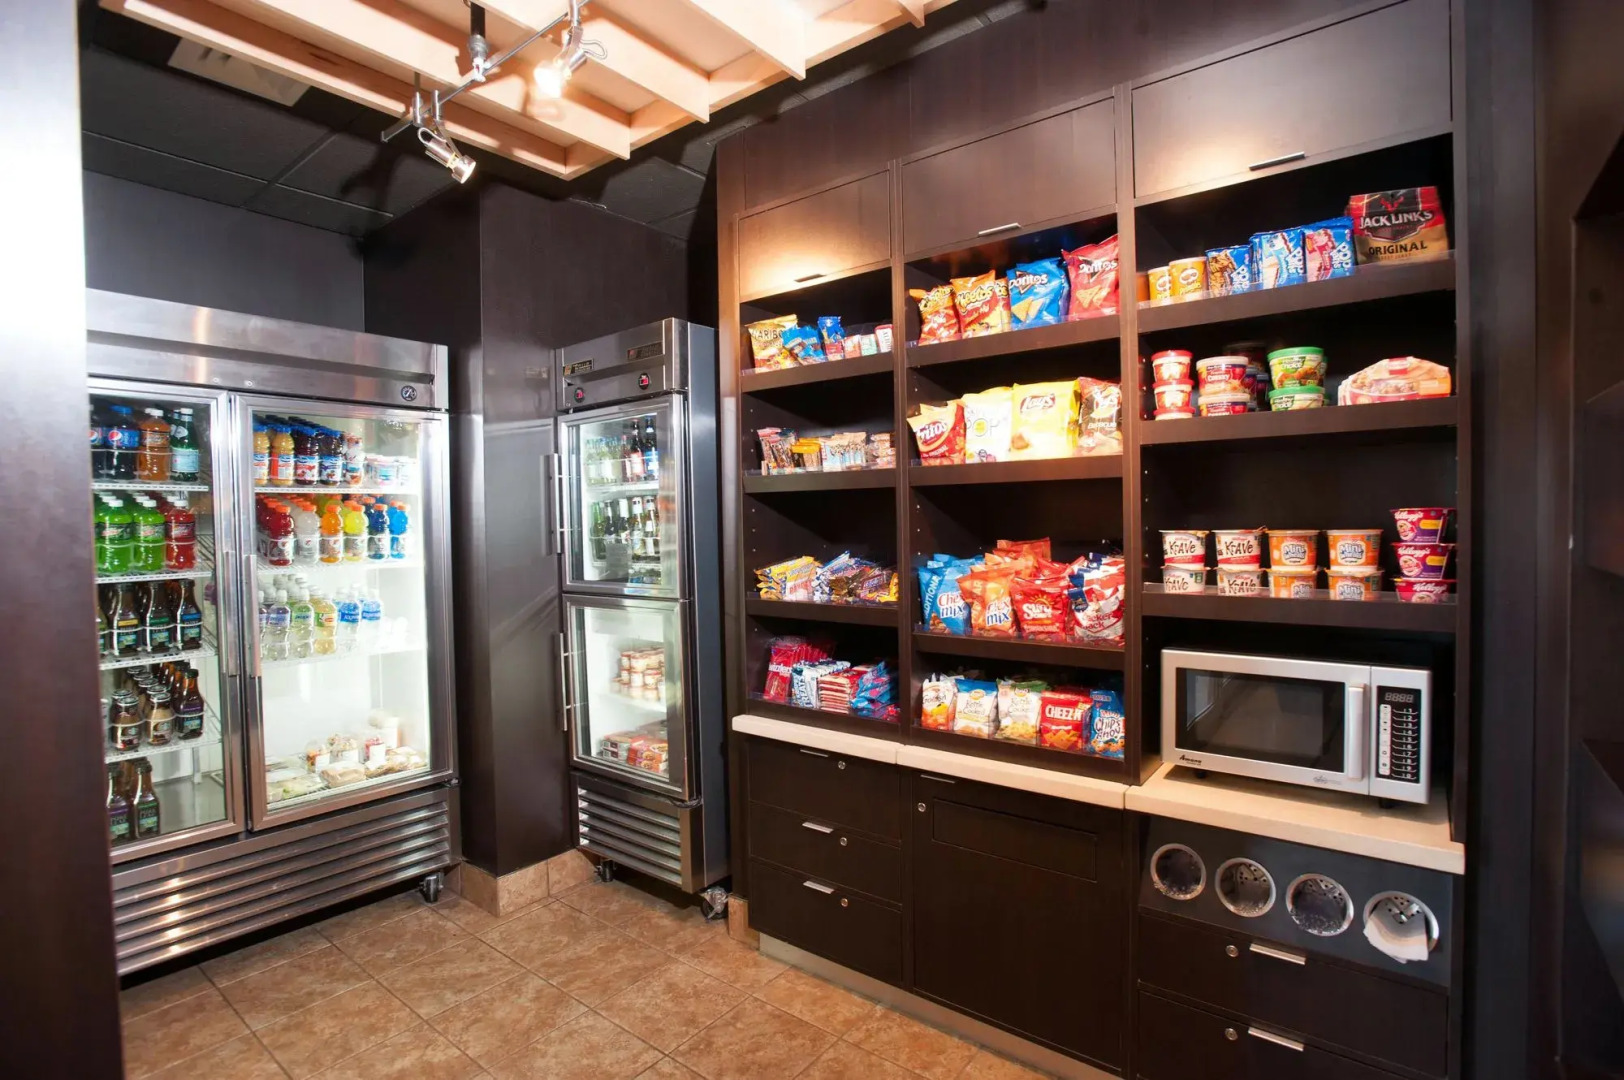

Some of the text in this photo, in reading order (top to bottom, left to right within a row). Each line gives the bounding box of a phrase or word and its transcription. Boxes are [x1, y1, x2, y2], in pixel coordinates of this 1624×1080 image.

[1359, 213, 1391, 229] JACK
[1368, 240, 1428, 256] ORIGINAL
[1009, 273, 1048, 290] Doritos
[1394, 511, 1424, 522] Kellogg's
[1283, 543, 1305, 554] Mini
[1340, 542, 1362, 554] Mini
[1397, 545, 1431, 558] Kellogg's
[1412, 582, 1448, 594] Kellogg's
[941, 604, 964, 618] mix
[986, 611, 1009, 626] mix
[1385, 692, 1414, 703] 8888
